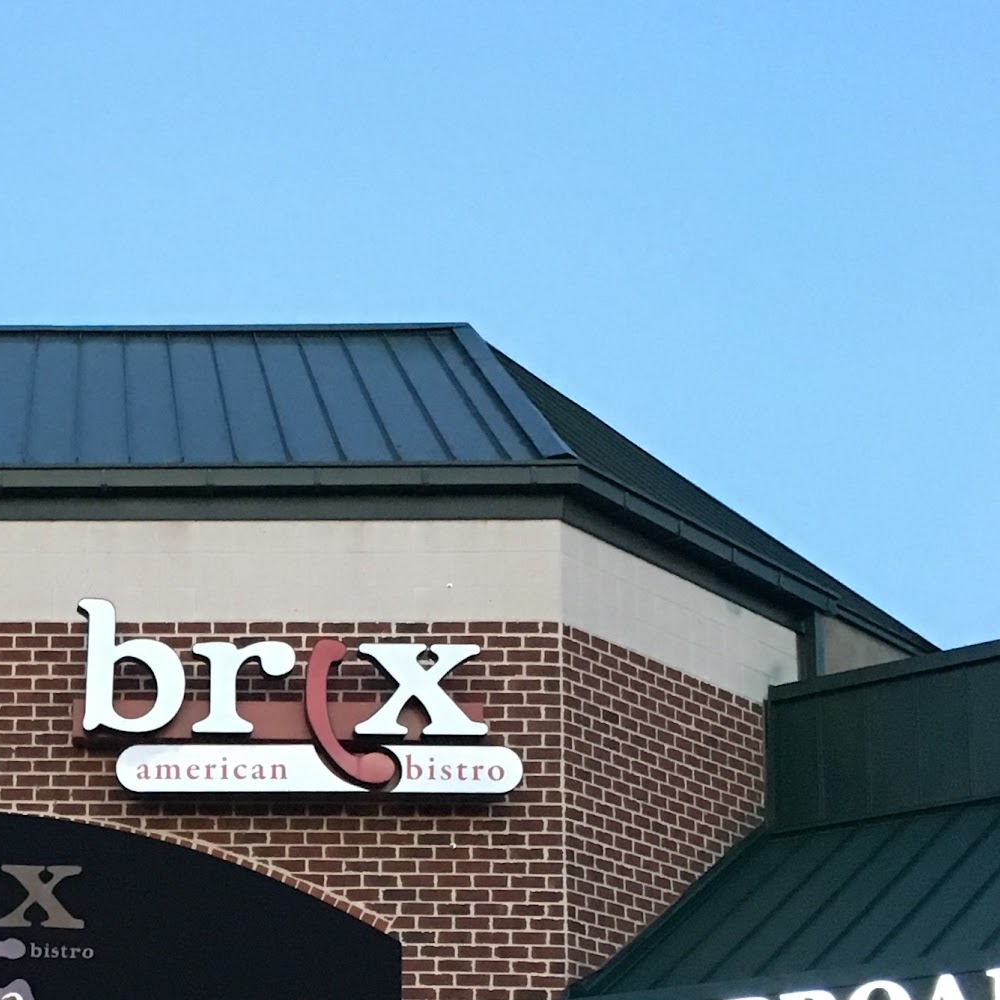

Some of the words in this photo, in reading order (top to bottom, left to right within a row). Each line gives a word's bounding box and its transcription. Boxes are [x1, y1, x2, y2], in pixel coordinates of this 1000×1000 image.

[77, 598, 489, 783] brix
[136, 756, 288, 780] american
[405, 754, 505, 782] bistro
[29, 942, 95, 959] bistro
